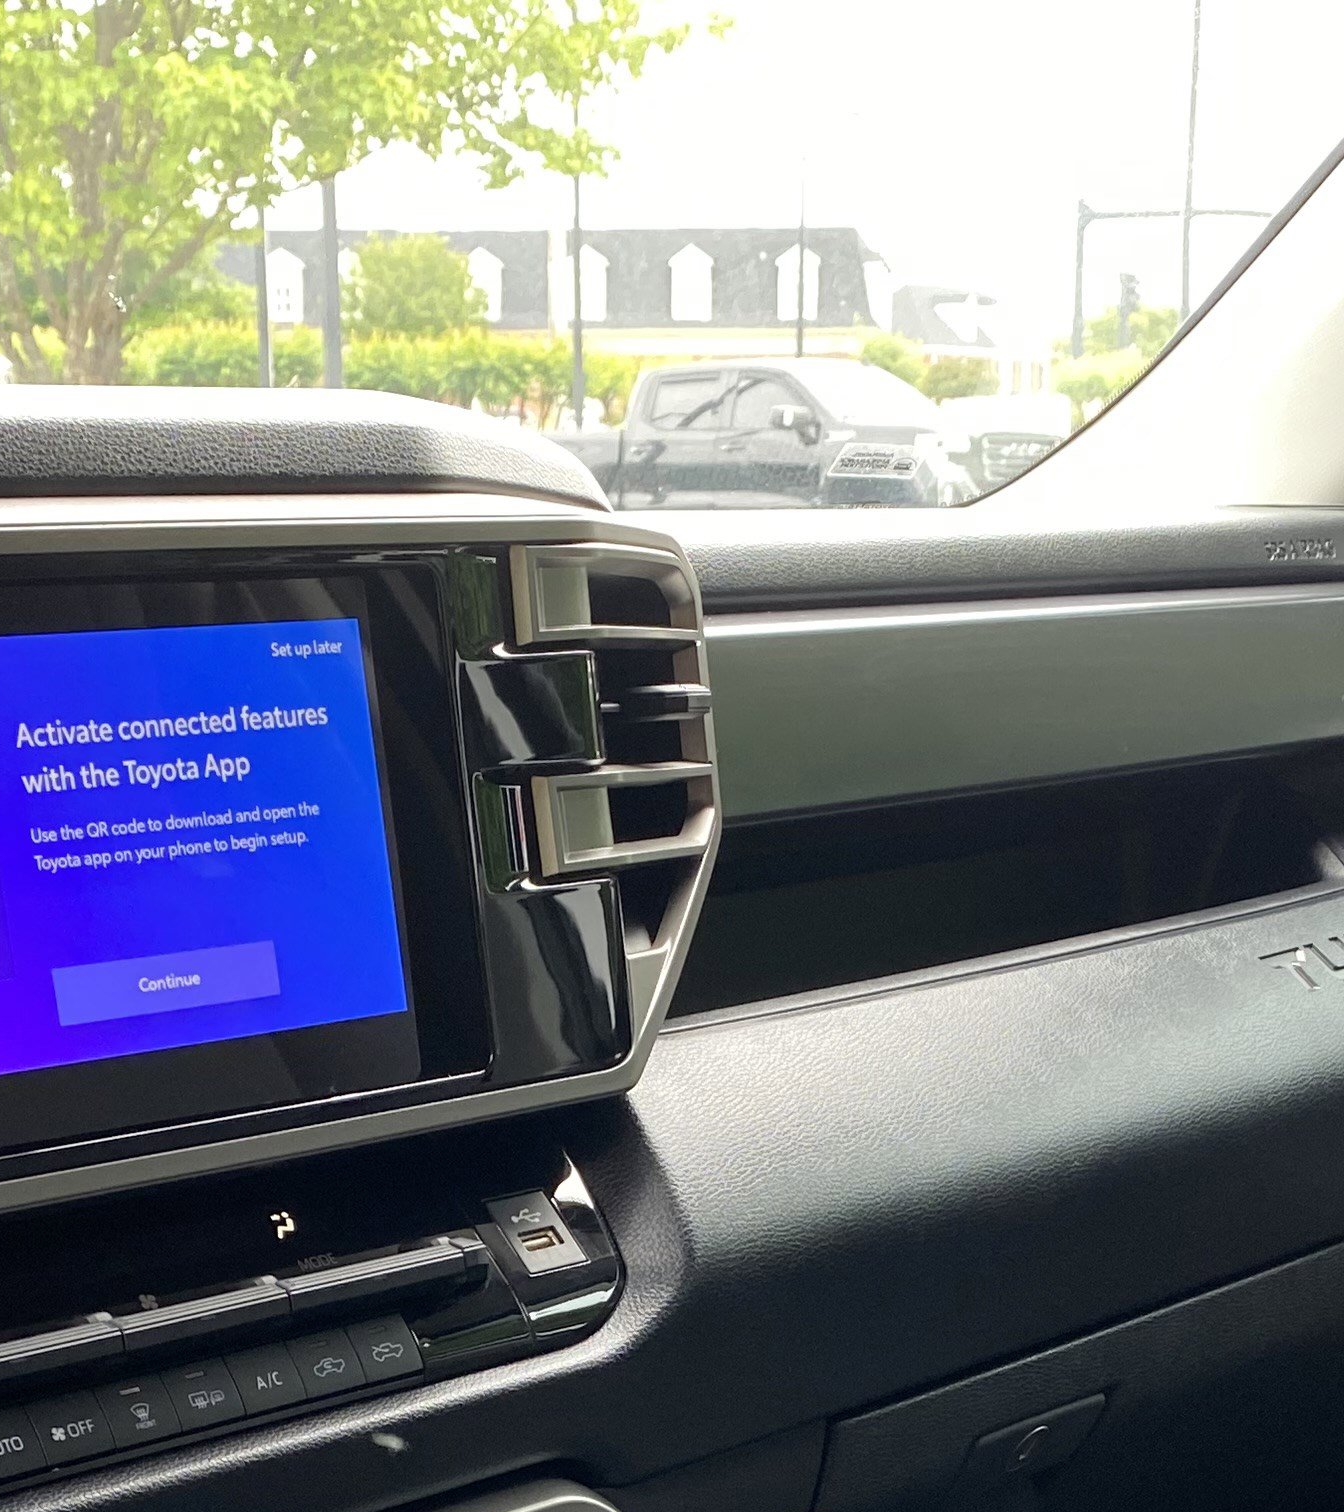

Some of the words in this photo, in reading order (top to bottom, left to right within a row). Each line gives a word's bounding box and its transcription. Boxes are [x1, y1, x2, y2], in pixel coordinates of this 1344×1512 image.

[271, 642, 293, 657] Set
[294, 643, 312, 659] up
[312, 639, 342, 655] later
[16, 719, 113, 748] Activate
[117, 706, 237, 740] connected
[240, 705, 329, 731] features
[21, 764, 76, 794] with
[79, 762, 120, 788] the
[123, 757, 199, 788] Toyota
[204, 752, 251, 782] App
[30, 828, 57, 844] Use
[60, 825, 84, 842] the
[86, 822, 109, 839] QR
[111, 817, 145, 835] code
[147, 818, 163, 833] to
[164, 809, 233, 830] download
[235, 806, 260, 823] and
[262, 804, 296, 824] open
[298, 801, 320, 817] the
[33, 853, 82, 874] Toyota
[83, 852, 112, 870] app
[114, 850, 133, 864] on
[135, 845, 166, 865] your
[168, 839, 212, 861] phone
[213, 837, 229, 853] to
[230, 831, 269, 853] begin
[270, 829, 309, 845] setup.
[138, 972, 201, 993] Continue
[298, 1253, 338, 1272] MODE
[257, 1371, 283, 1390] A/C
[67, 1419, 94, 1438] OFF
